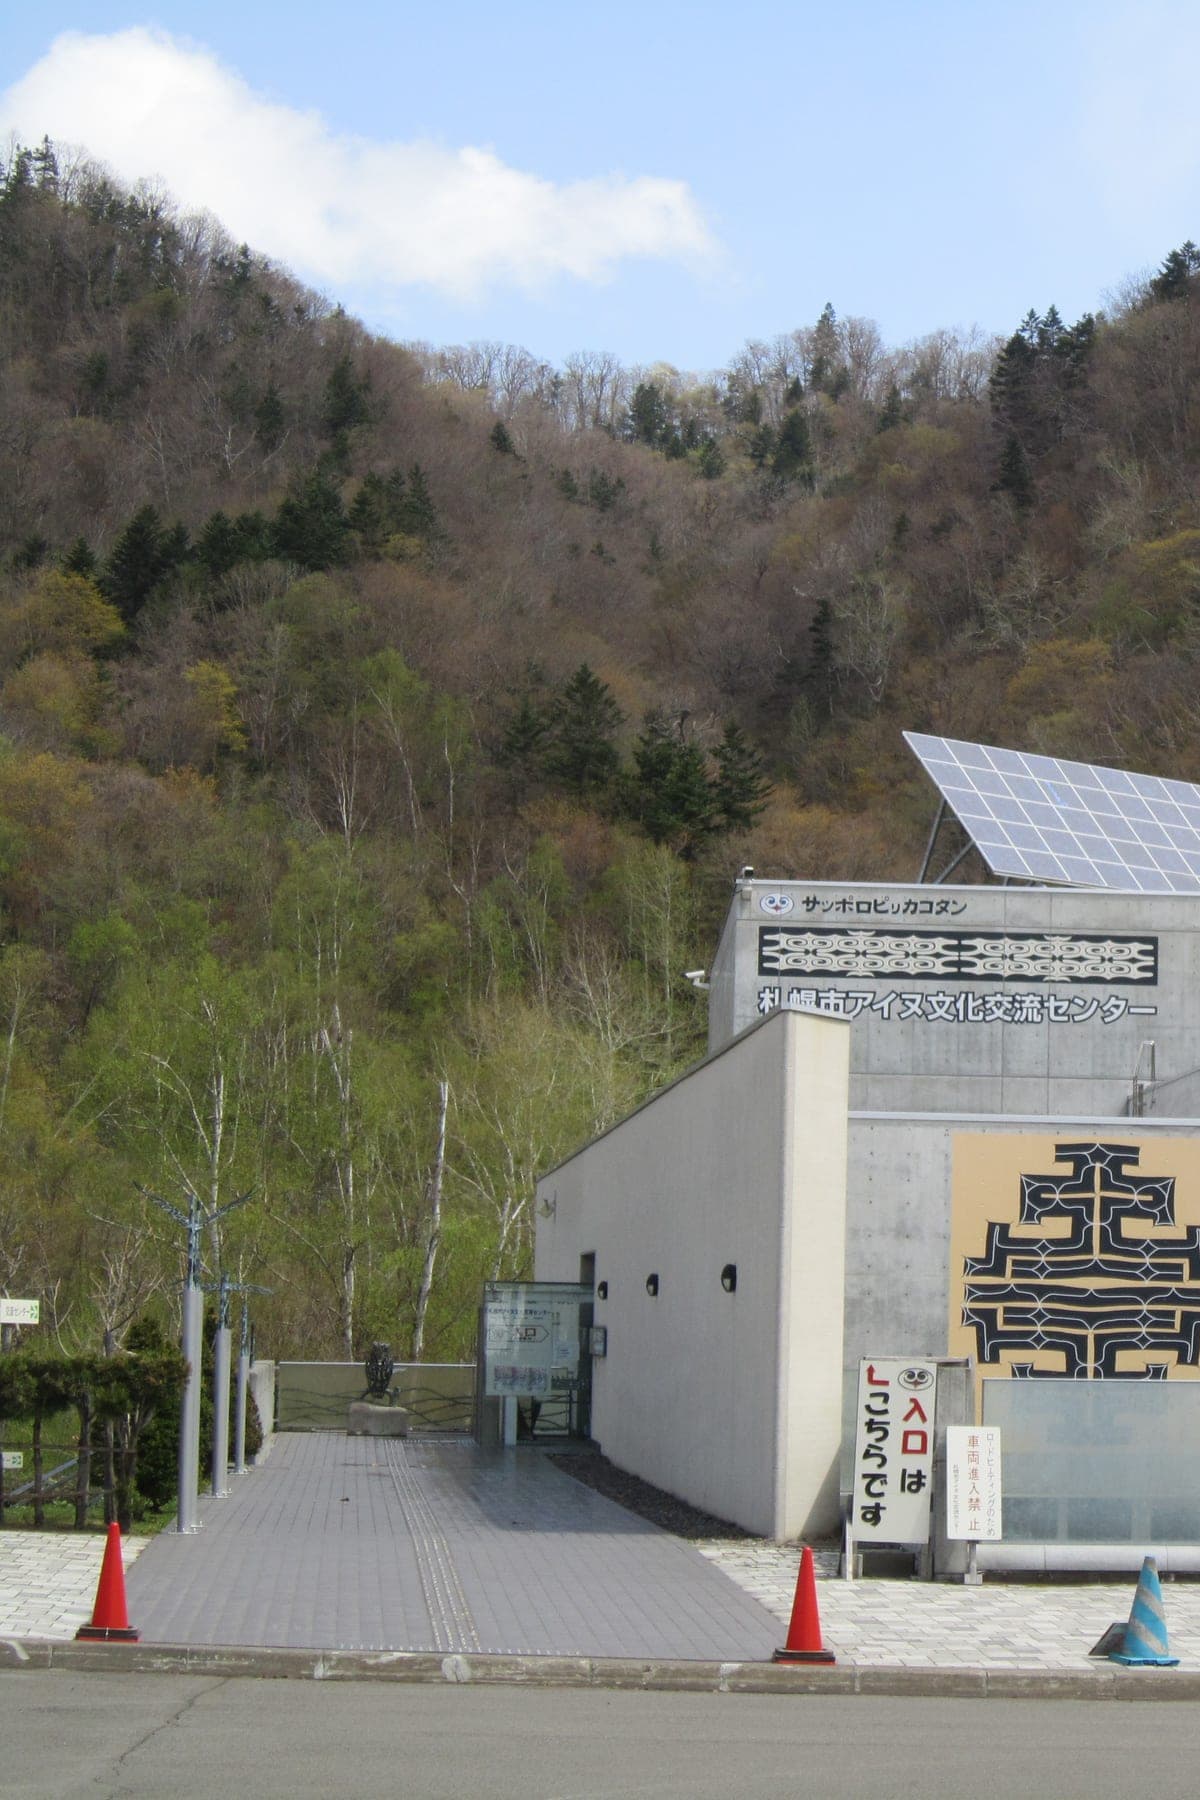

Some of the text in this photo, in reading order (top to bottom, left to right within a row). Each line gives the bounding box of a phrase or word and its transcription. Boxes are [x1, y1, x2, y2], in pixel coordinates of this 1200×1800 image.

[860, 1392, 890, 1528] こちらです
[900, 1397, 928, 1495] 入口は
[967, 1434, 981, 1532] 車両進入禁止
